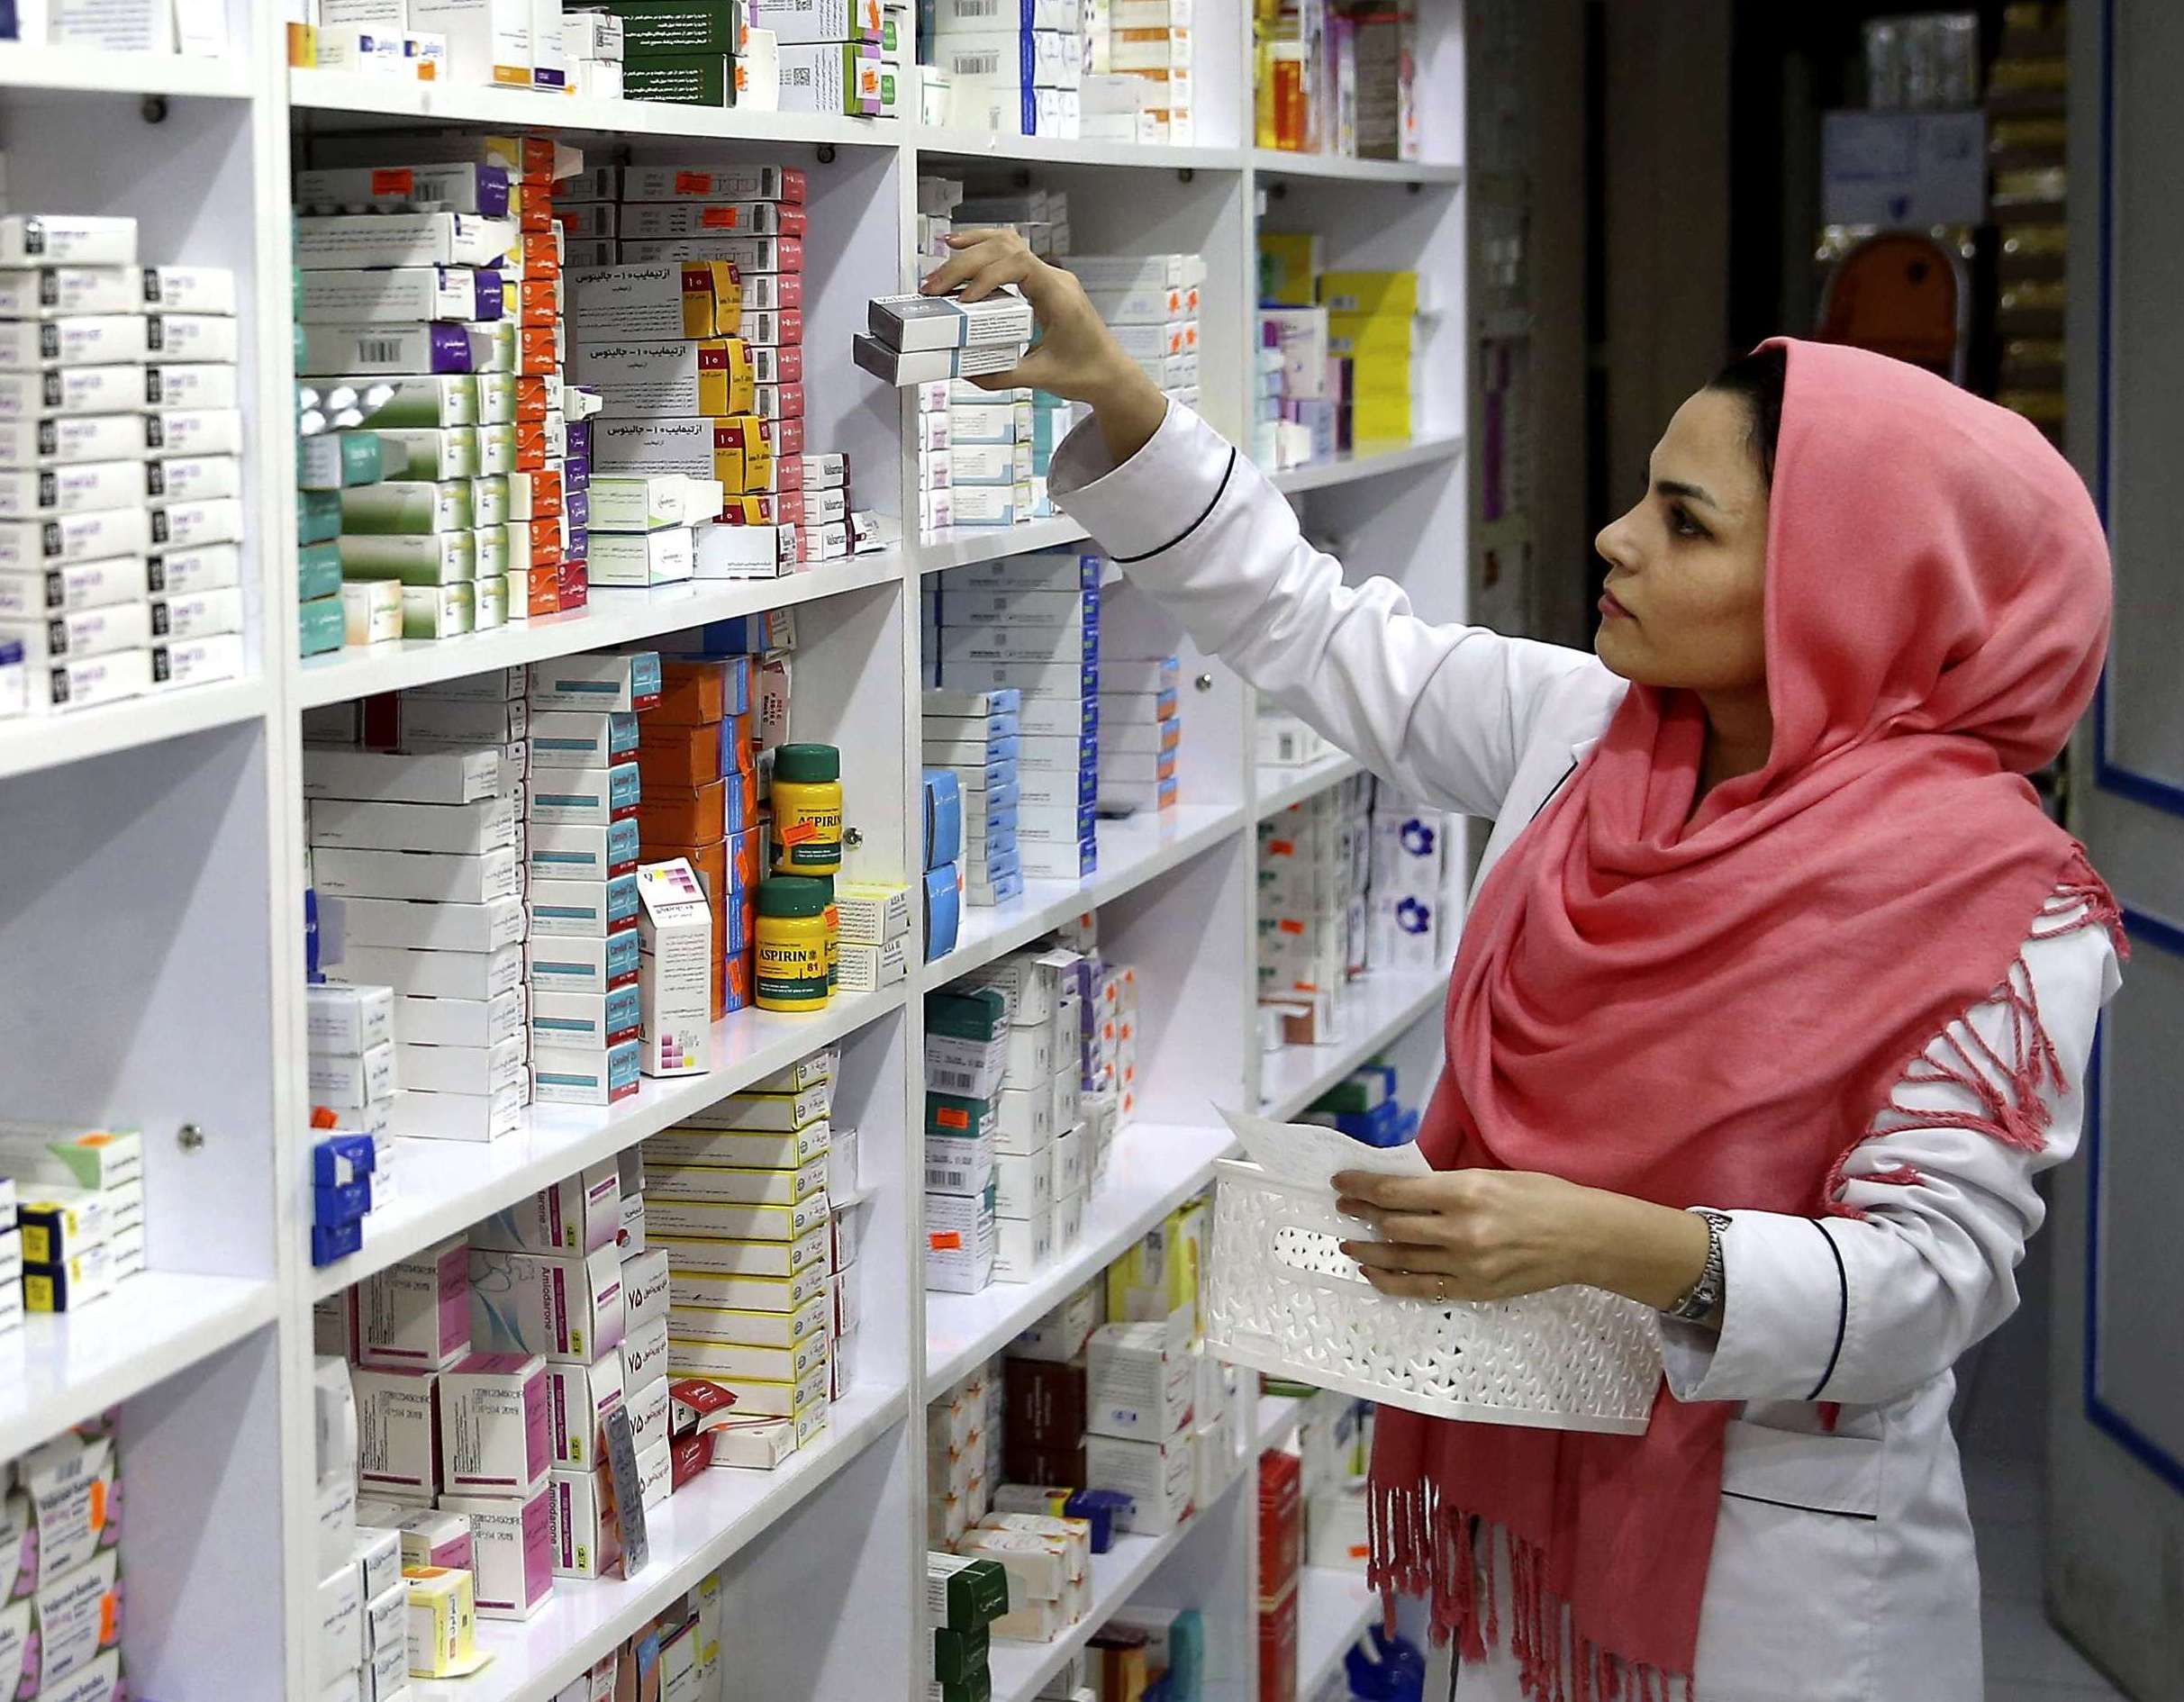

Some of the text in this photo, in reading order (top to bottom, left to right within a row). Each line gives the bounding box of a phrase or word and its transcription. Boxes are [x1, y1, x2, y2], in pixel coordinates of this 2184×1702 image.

[759, 950, 807, 962] ASPIRIN
[541, 1266, 552, 1331] Amiodarone
[548, 1480, 557, 1546] Amiodarone
